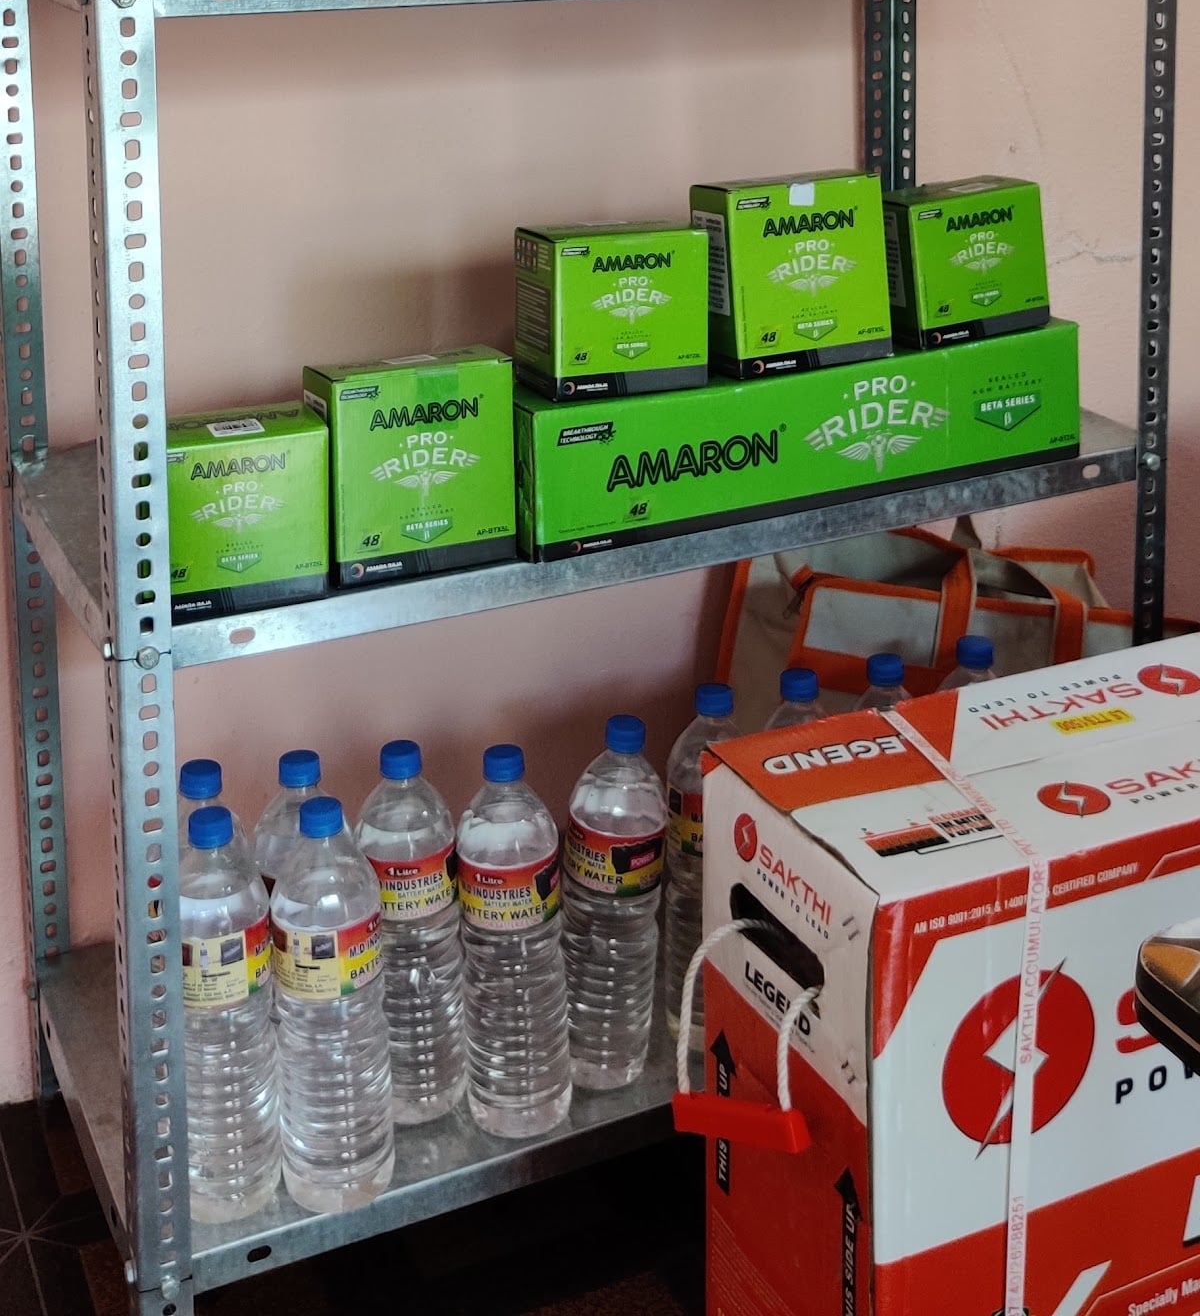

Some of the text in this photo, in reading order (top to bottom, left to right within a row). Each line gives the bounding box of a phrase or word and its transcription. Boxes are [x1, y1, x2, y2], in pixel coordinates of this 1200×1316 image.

[762, 207, 855, 238] AMARON
[945, 206, 1014, 233] AMARON
[794, 238, 830, 254] PRO
[969, 230, 995, 243] PRO
[592, 251, 672, 273] AMARON
[957, 241, 1008, 264] RIDER
[775, 253, 848, 281] RIDER
[618, 275, 648, 288] PRO
[601, 287, 663, 309] RIDER
[760, 330, 777, 343] 48
[574, 351, 588, 362] 48
[853, 374, 907, 401] PRO
[369, 396, 479, 432] AMARON
[980, 394, 1036, 413] BETA SERIES
[820, 398, 935, 447] RIDER
[406, 430, 448, 450] PRO
[190, 452, 286, 481] AMARON
[382, 447, 469, 479] RIDER
[606, 429, 778, 493] AMARON
[222, 480, 259, 496] PRO
[201, 493, 277, 520] RIDER
[629, 501, 648, 516] 48
[405, 518, 449, 532] BETA SERIES
[362, 533, 381, 547] 48
[221, 552, 259, 564] BETA SERIES
[967, 673, 1122, 713] POWER TO LEAD
[979, 682, 1144, 731] SAKTHI
[762, 734, 908, 775] EGEND
[1129, 781, 1199, 804] POWER
[385, 871, 443, 891] INDUSTRIES
[387, 867, 395, 876] 1
[475, 873, 504, 885] 1 Litre
[583, 867, 624, 885] WATER
[473, 886, 532, 900] INDUSTRIES
[758, 843, 832, 926] SAKTHI
[755, 867, 830, 940] POWER TO LEAD
[913, 920, 928, 935] AN
[929, 916, 946, 931] ISO
[947, 904, 993, 926] 9001:2015
[1051, 874, 1095, 896] CERTIFIED
[1096, 861, 1139, 885] COMPANY
[509, 901, 549, 920] WATER
[1019, 1000, 1036, 1065] SAKTHI
[719, 1062, 729, 1091] UP
[844, 1203, 856, 1281] SIDE UP
[1127, 1288, 1179, 1316] Specially
